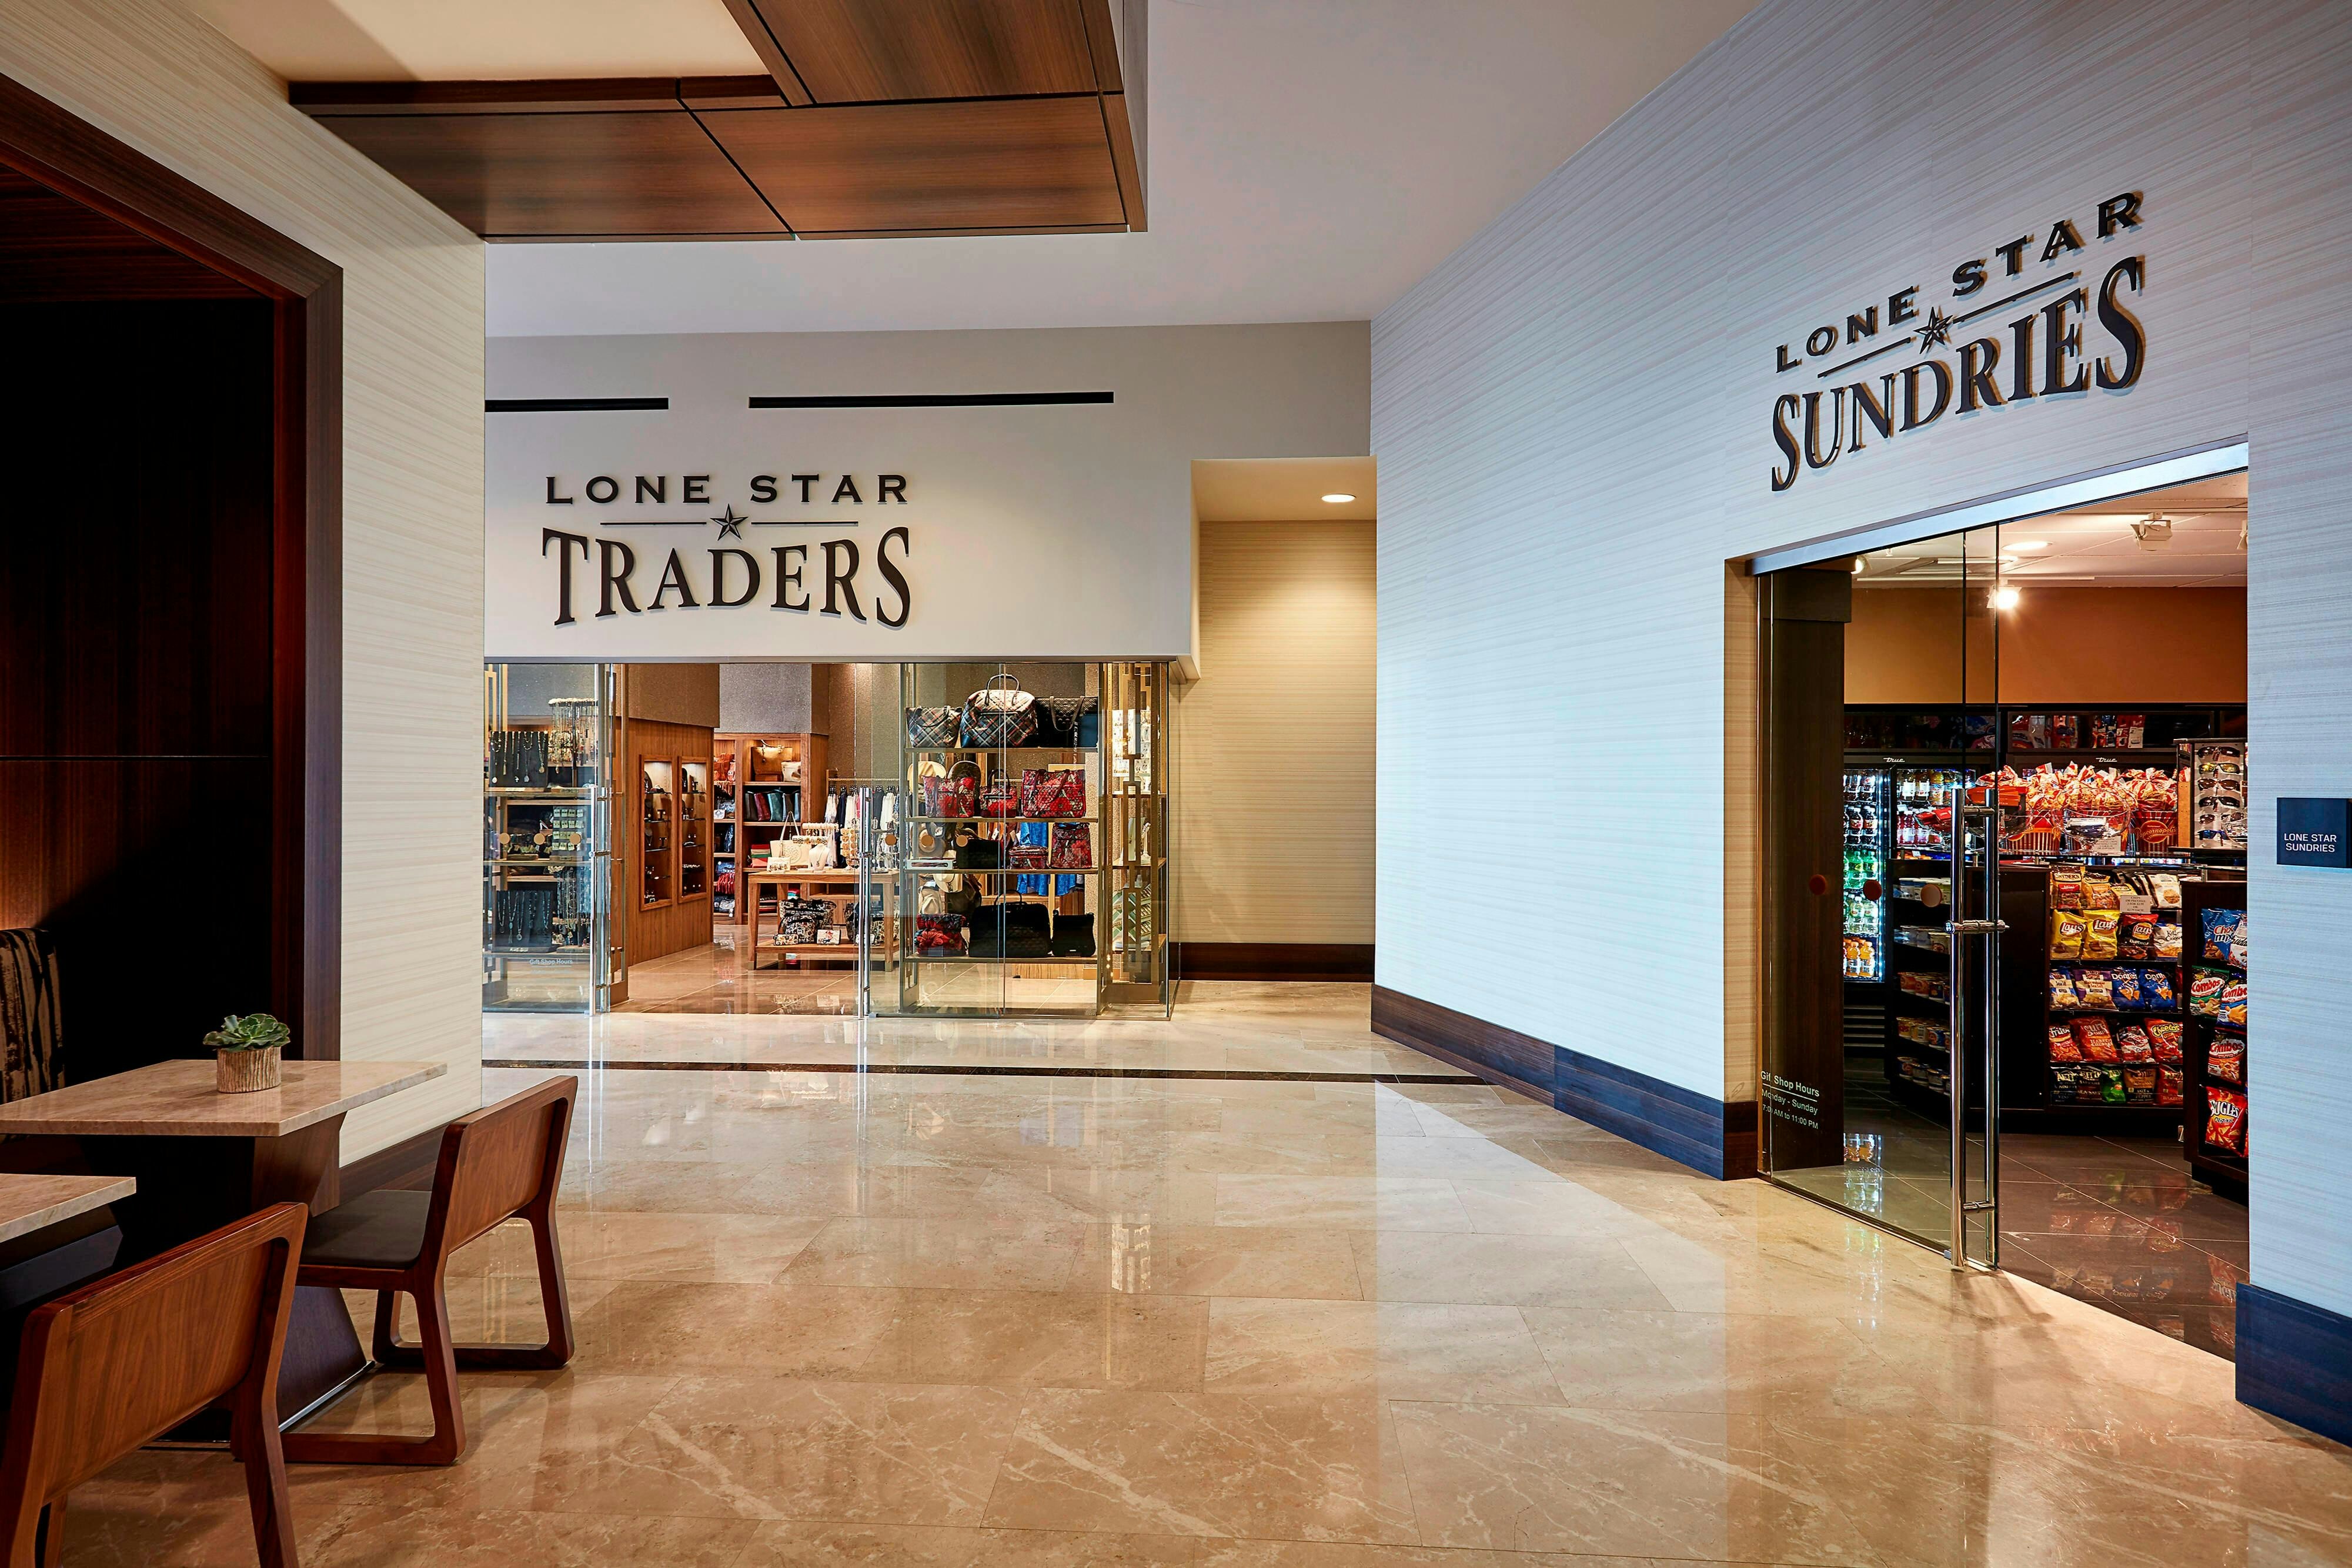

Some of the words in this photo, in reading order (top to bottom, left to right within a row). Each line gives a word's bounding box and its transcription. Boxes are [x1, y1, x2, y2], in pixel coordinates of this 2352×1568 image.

[1776, 286, 1919, 373] LONE
[1952, 191, 2143, 297] STAR
[1772, 255, 2145, 492] SUNDRIES
[546, 474, 710, 504] LONE
[750, 474, 907, 503] STAR
[542, 527, 911, 628] TRADERS
[2284, 833, 2308, 841] LONE
[2311, 834, 2337, 842] STAR
[2286, 842, 2335, 852] SUNDRIES
[2214, 925, 2236, 935] Chex
[2191, 979, 2221, 992] Combos
[2152, 1024, 2180, 1037] Cheetos
[2210, 1040, 2244, 1054] Combos
[1774, 1075, 1793, 1091] Shop
[1796, 1082, 1820, 1097] Hours
[1792, 1099, 1818, 1115] Sunday
[1773, 1109, 1783, 1117] AM
[1792, 1115, 1807, 1125] 11:00
[1808, 1120, 1819, 1129] PM
